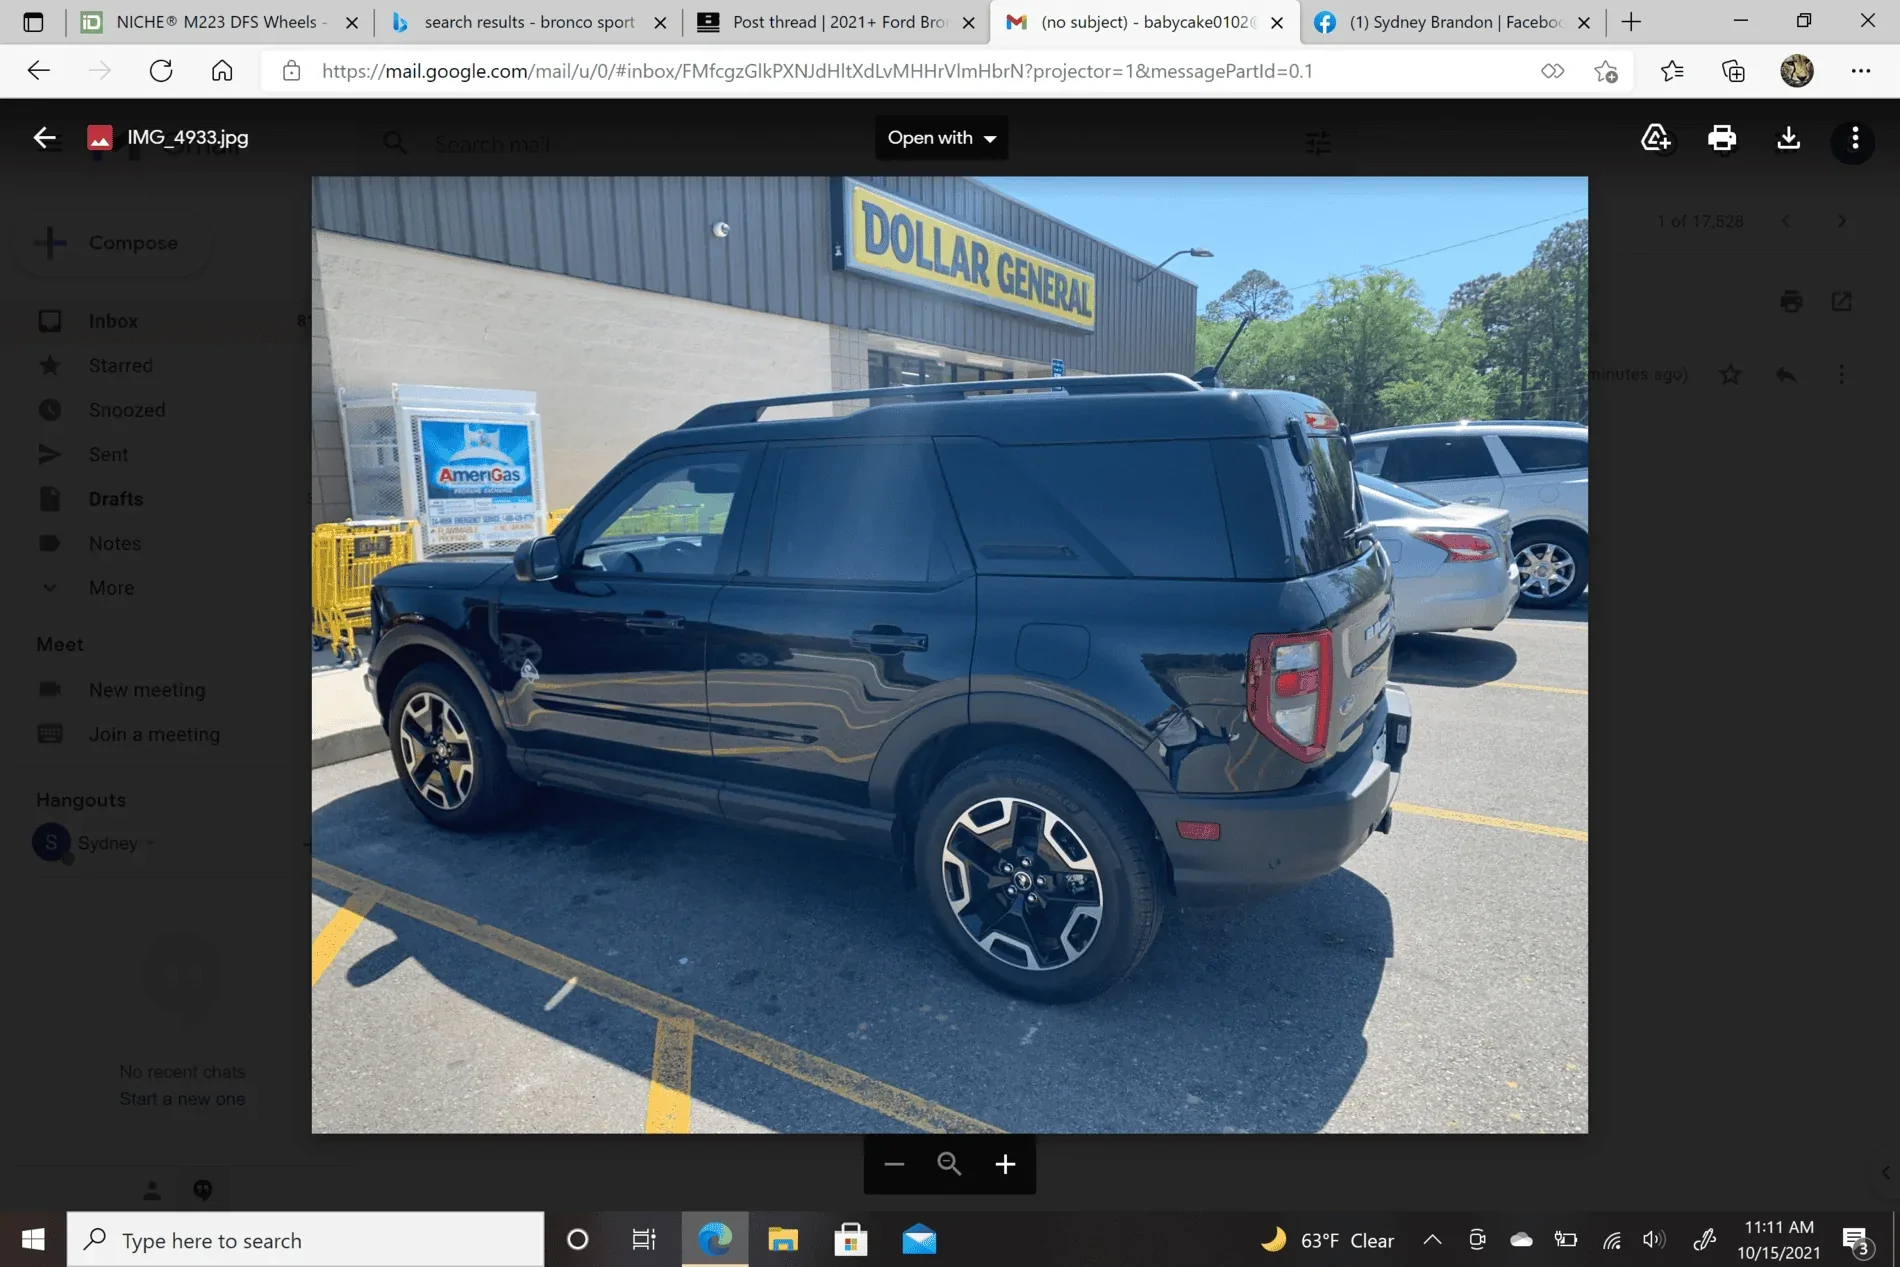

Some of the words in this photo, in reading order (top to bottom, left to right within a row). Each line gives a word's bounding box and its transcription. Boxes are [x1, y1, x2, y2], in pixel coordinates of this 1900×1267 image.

[184, 15, 226, 29] M223
[230, 15, 259, 29] DFS
[263, 14, 317, 29] Wheels
[424, 14, 473, 29] search
[477, 14, 525, 29] results
[540, 14, 593, 29] bronco
[597, 15, 635, 33] sport
[734, 15, 765, 29] Post
[769, 14, 817, 29] thread
[830, 15, 877, 29] 2021+
[882, 14, 916, 29] Ford
[1041, 15, 1067, 32] (no
[1071, 14, 1128, 33] subject)
[1350, 15, 1369, 32] (1)
[1374, 14, 1427, 33] Sydney
[1431, 14, 1493, 29] Brandon
[128, 128, 249, 149] IMG_4933.jpg
[888, 129, 934, 149] Open
[937, 129, 974, 145] with
[89, 234, 179, 256] Compose
[861, 199, 990, 288] DOLLAR
[997, 252, 1093, 319] GENERAL
[89, 312, 139, 330] Inbox
[89, 357, 154, 375] Starred
[89, 401, 167, 419] Snoozed
[89, 446, 129, 463] Sent
[439, 468, 521, 483] AmeriGas
[89, 490, 145, 507] Drafts
[89, 535, 142, 552] Notes
[89, 579, 136, 597] More
[36, 636, 85, 653] Meet
[89, 682, 129, 698] New
[134, 681, 206, 702] meeting
[88, 726, 127, 743] Join
[132, 730, 143, 743] a
[148, 726, 221, 746] meeting
[36, 791, 127, 812] Hangouts
[45, 834, 57, 849] S
[78, 835, 138, 854] Sydney
[120, 1064, 144, 1079] No
[148, 1065, 198, 1080] recent
[203, 1064, 246, 1080] chats
[120, 1091, 158, 1106] Start
[163, 1094, 172, 1106] a
[178, 1094, 211, 1106] new
[215, 1094, 246, 1106] one
[1745, 1220, 1782, 1234] 11:11
[1788, 1220, 1815, 1234] AM
[121, 1232, 166, 1254] Type
[172, 1231, 213, 1249] here
[217, 1234, 238, 1249] to
[243, 1231, 302, 1250] search
[1301, 1232, 1340, 1249] 63°F
[1350, 1232, 1395, 1249] Clear
[1859, 1242, 1868, 1256] 3
[1737, 1246, 1820, 1262] 10/15/2021
